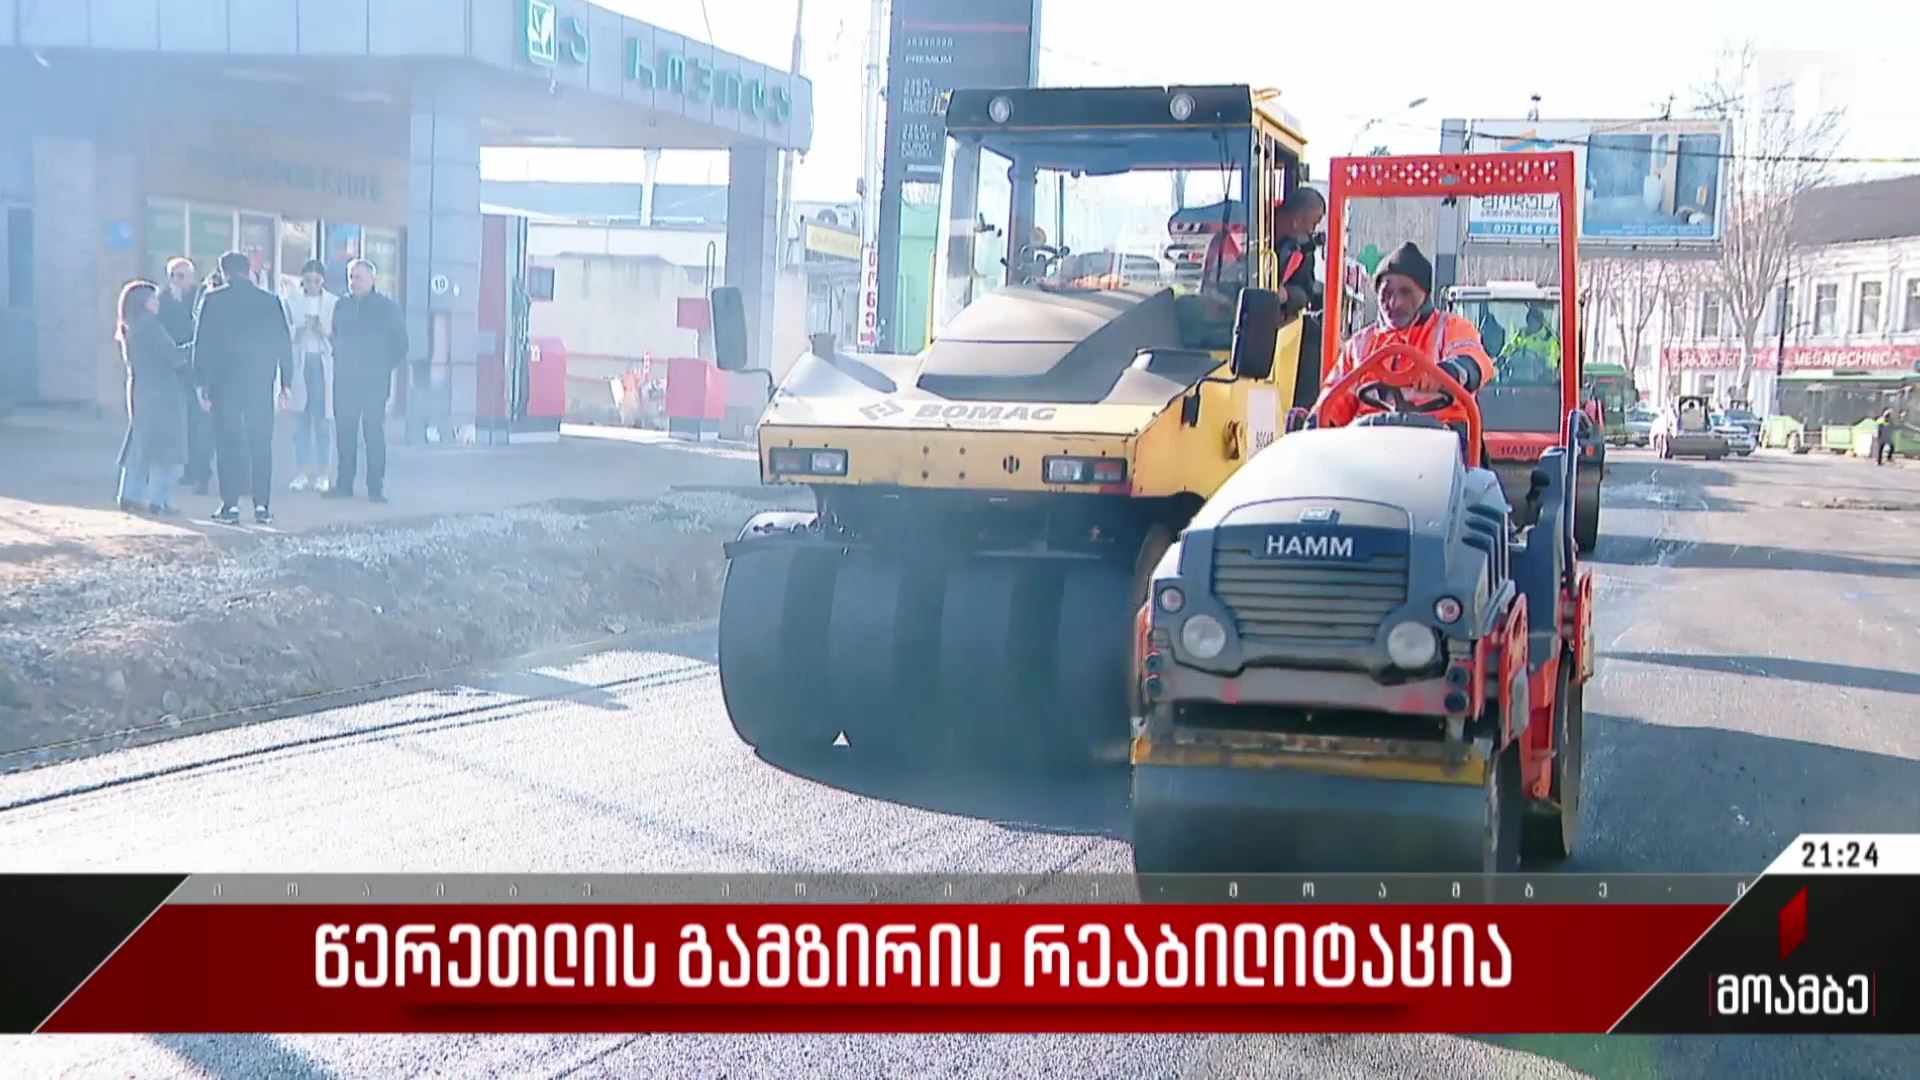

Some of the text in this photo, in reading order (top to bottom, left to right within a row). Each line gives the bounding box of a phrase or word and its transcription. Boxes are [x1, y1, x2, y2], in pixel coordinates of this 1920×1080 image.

[904, 53, 954, 65] PREMIUM
[434, 278, 446, 290] 10
[914, 403, 1057, 421] BOMAG
[1266, 535, 1354, 557] HAMM
